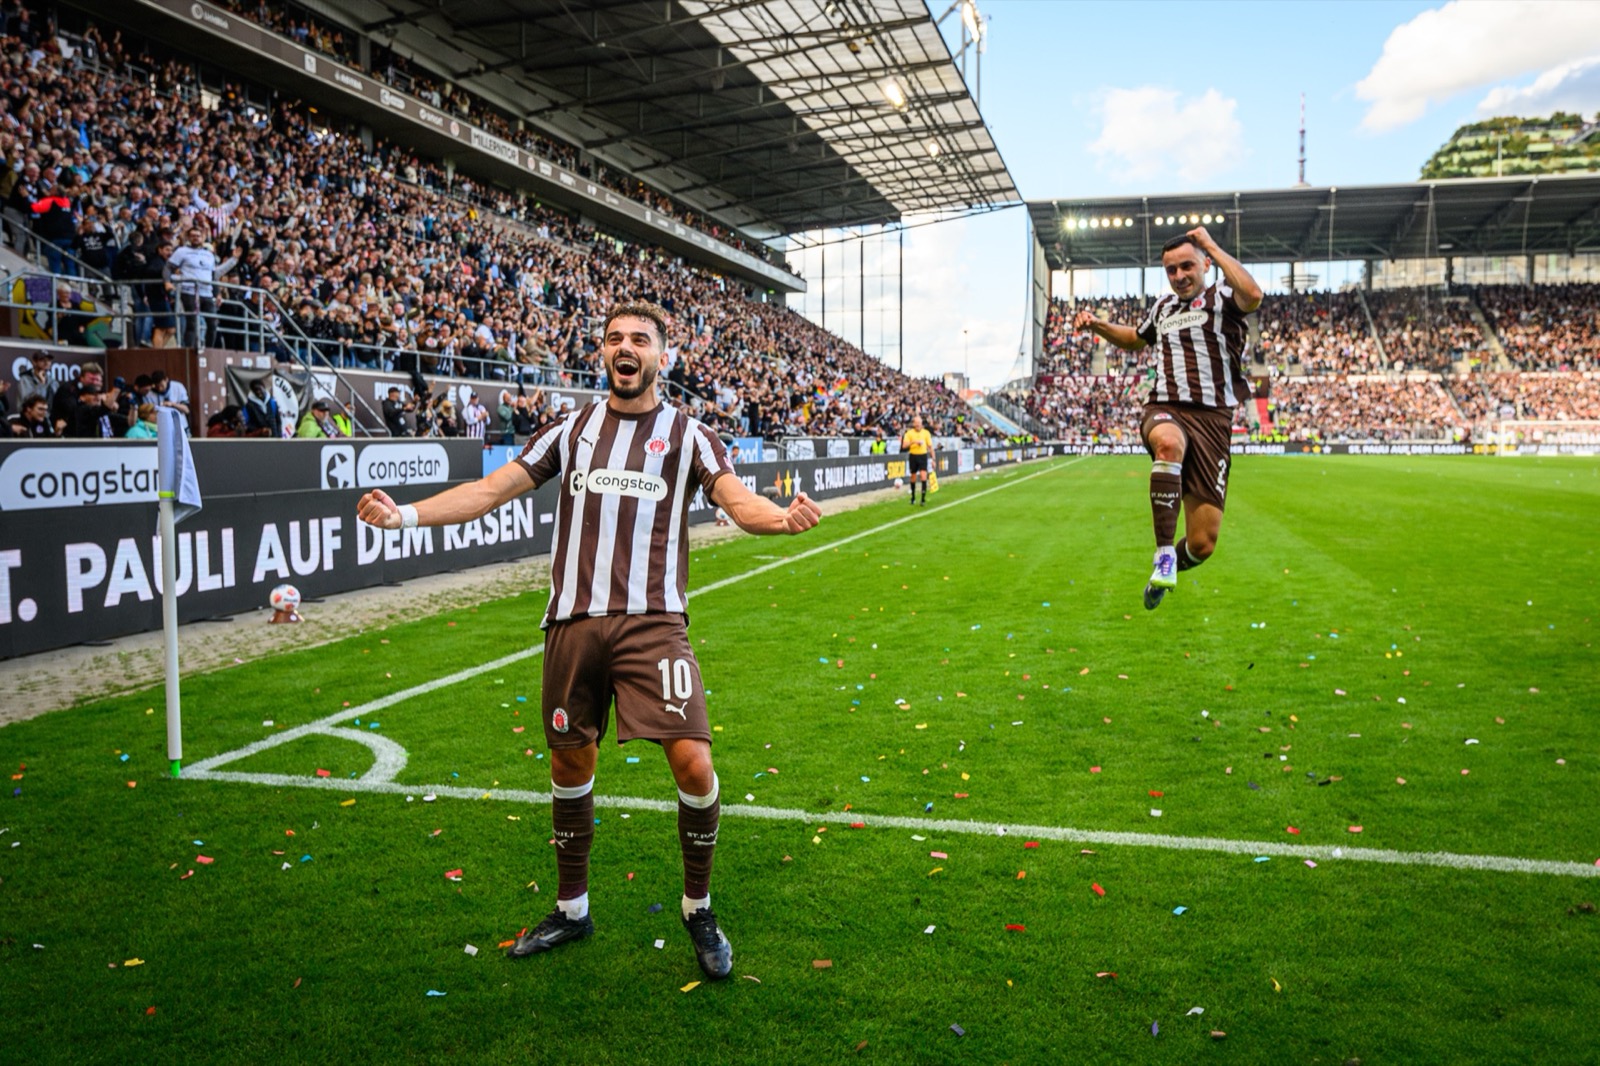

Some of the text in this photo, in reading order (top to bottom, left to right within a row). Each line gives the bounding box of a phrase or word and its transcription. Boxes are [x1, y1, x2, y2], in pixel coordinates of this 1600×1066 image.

[473, 132, 516, 161] MILLERNTOR
[1163, 315, 1203, 330] congstar
[275, 376, 292, 399] Club
[20, 463, 159, 503] congstar
[369, 455, 440, 485] congstar
[595, 475, 660, 493] congstar
[64, 527, 236, 613] PAULI
[252, 516, 342, 583] AUF
[357, 515, 434, 566] DEM
[444, 498, 534, 551] RASEN
[657, 658, 693, 700] 10
